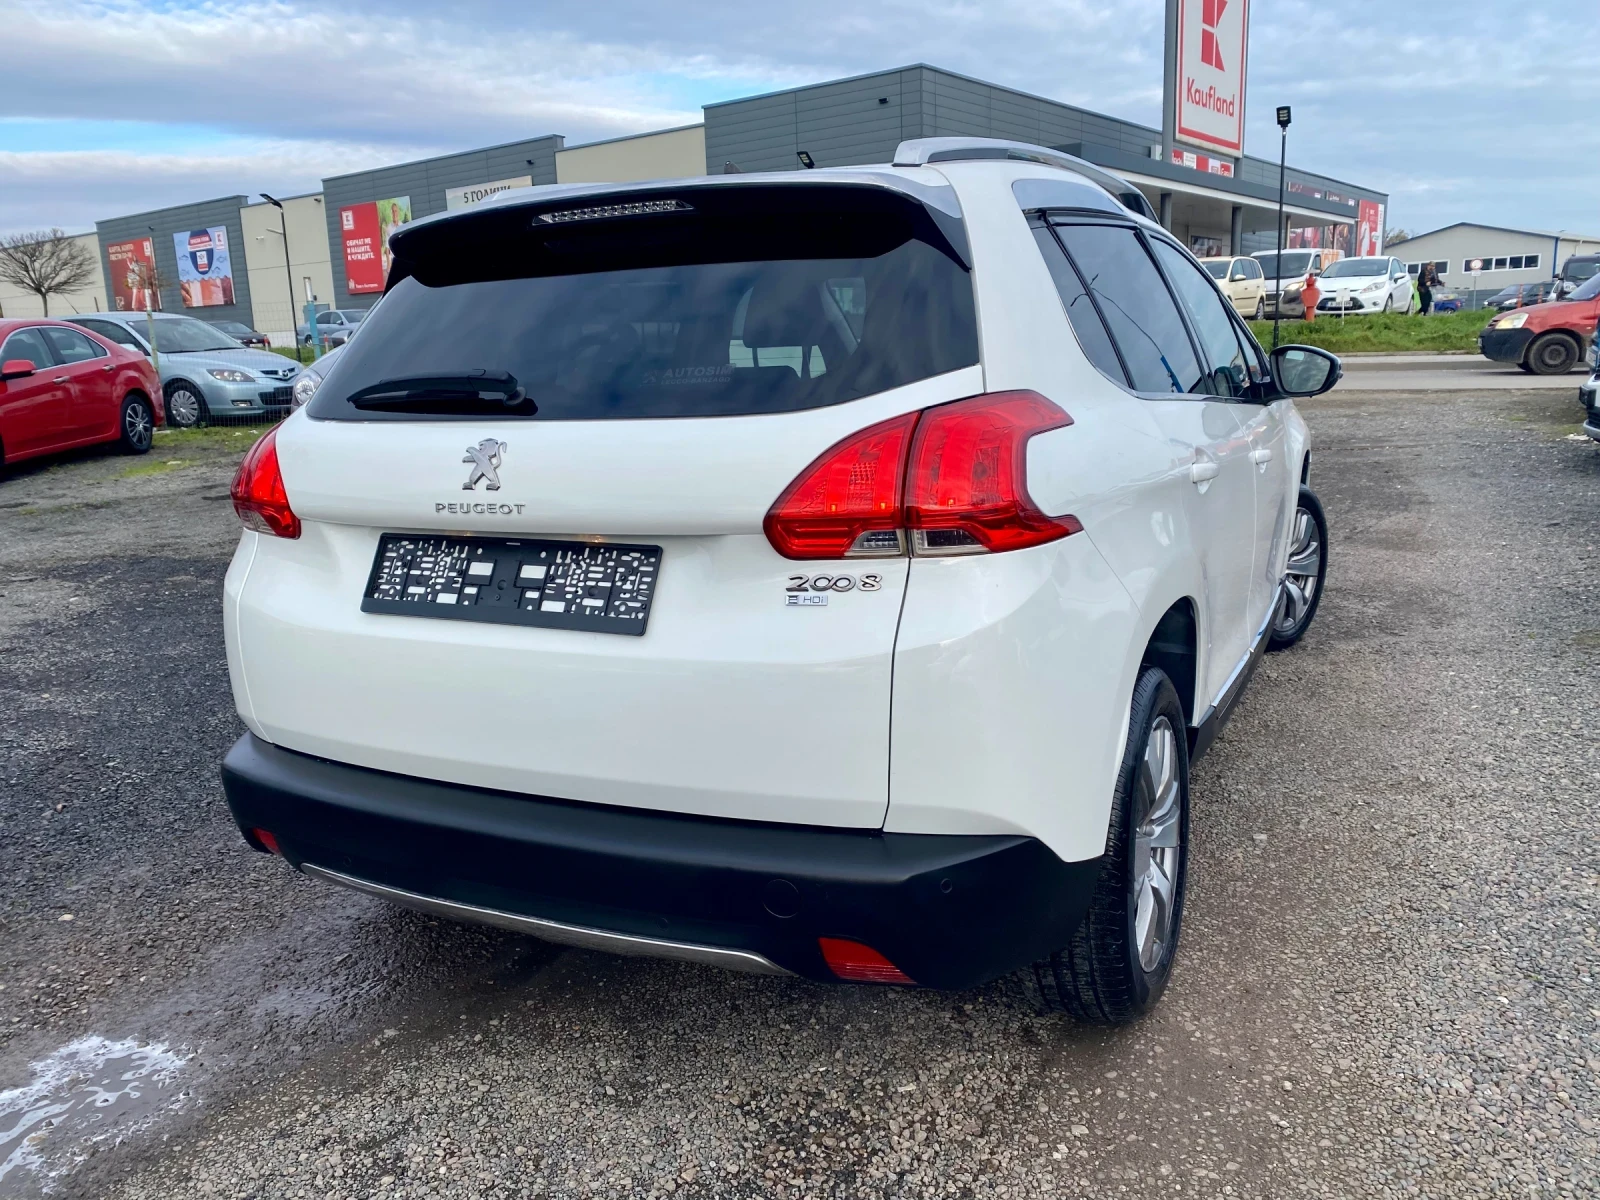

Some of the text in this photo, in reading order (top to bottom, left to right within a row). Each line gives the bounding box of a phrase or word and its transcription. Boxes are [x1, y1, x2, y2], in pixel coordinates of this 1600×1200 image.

[1186, 77, 1235, 118] Kaufland
[463, 192, 469, 203] 5
[435, 502, 526, 515] PEUGEOT
[785, 572, 883, 592] 2008
